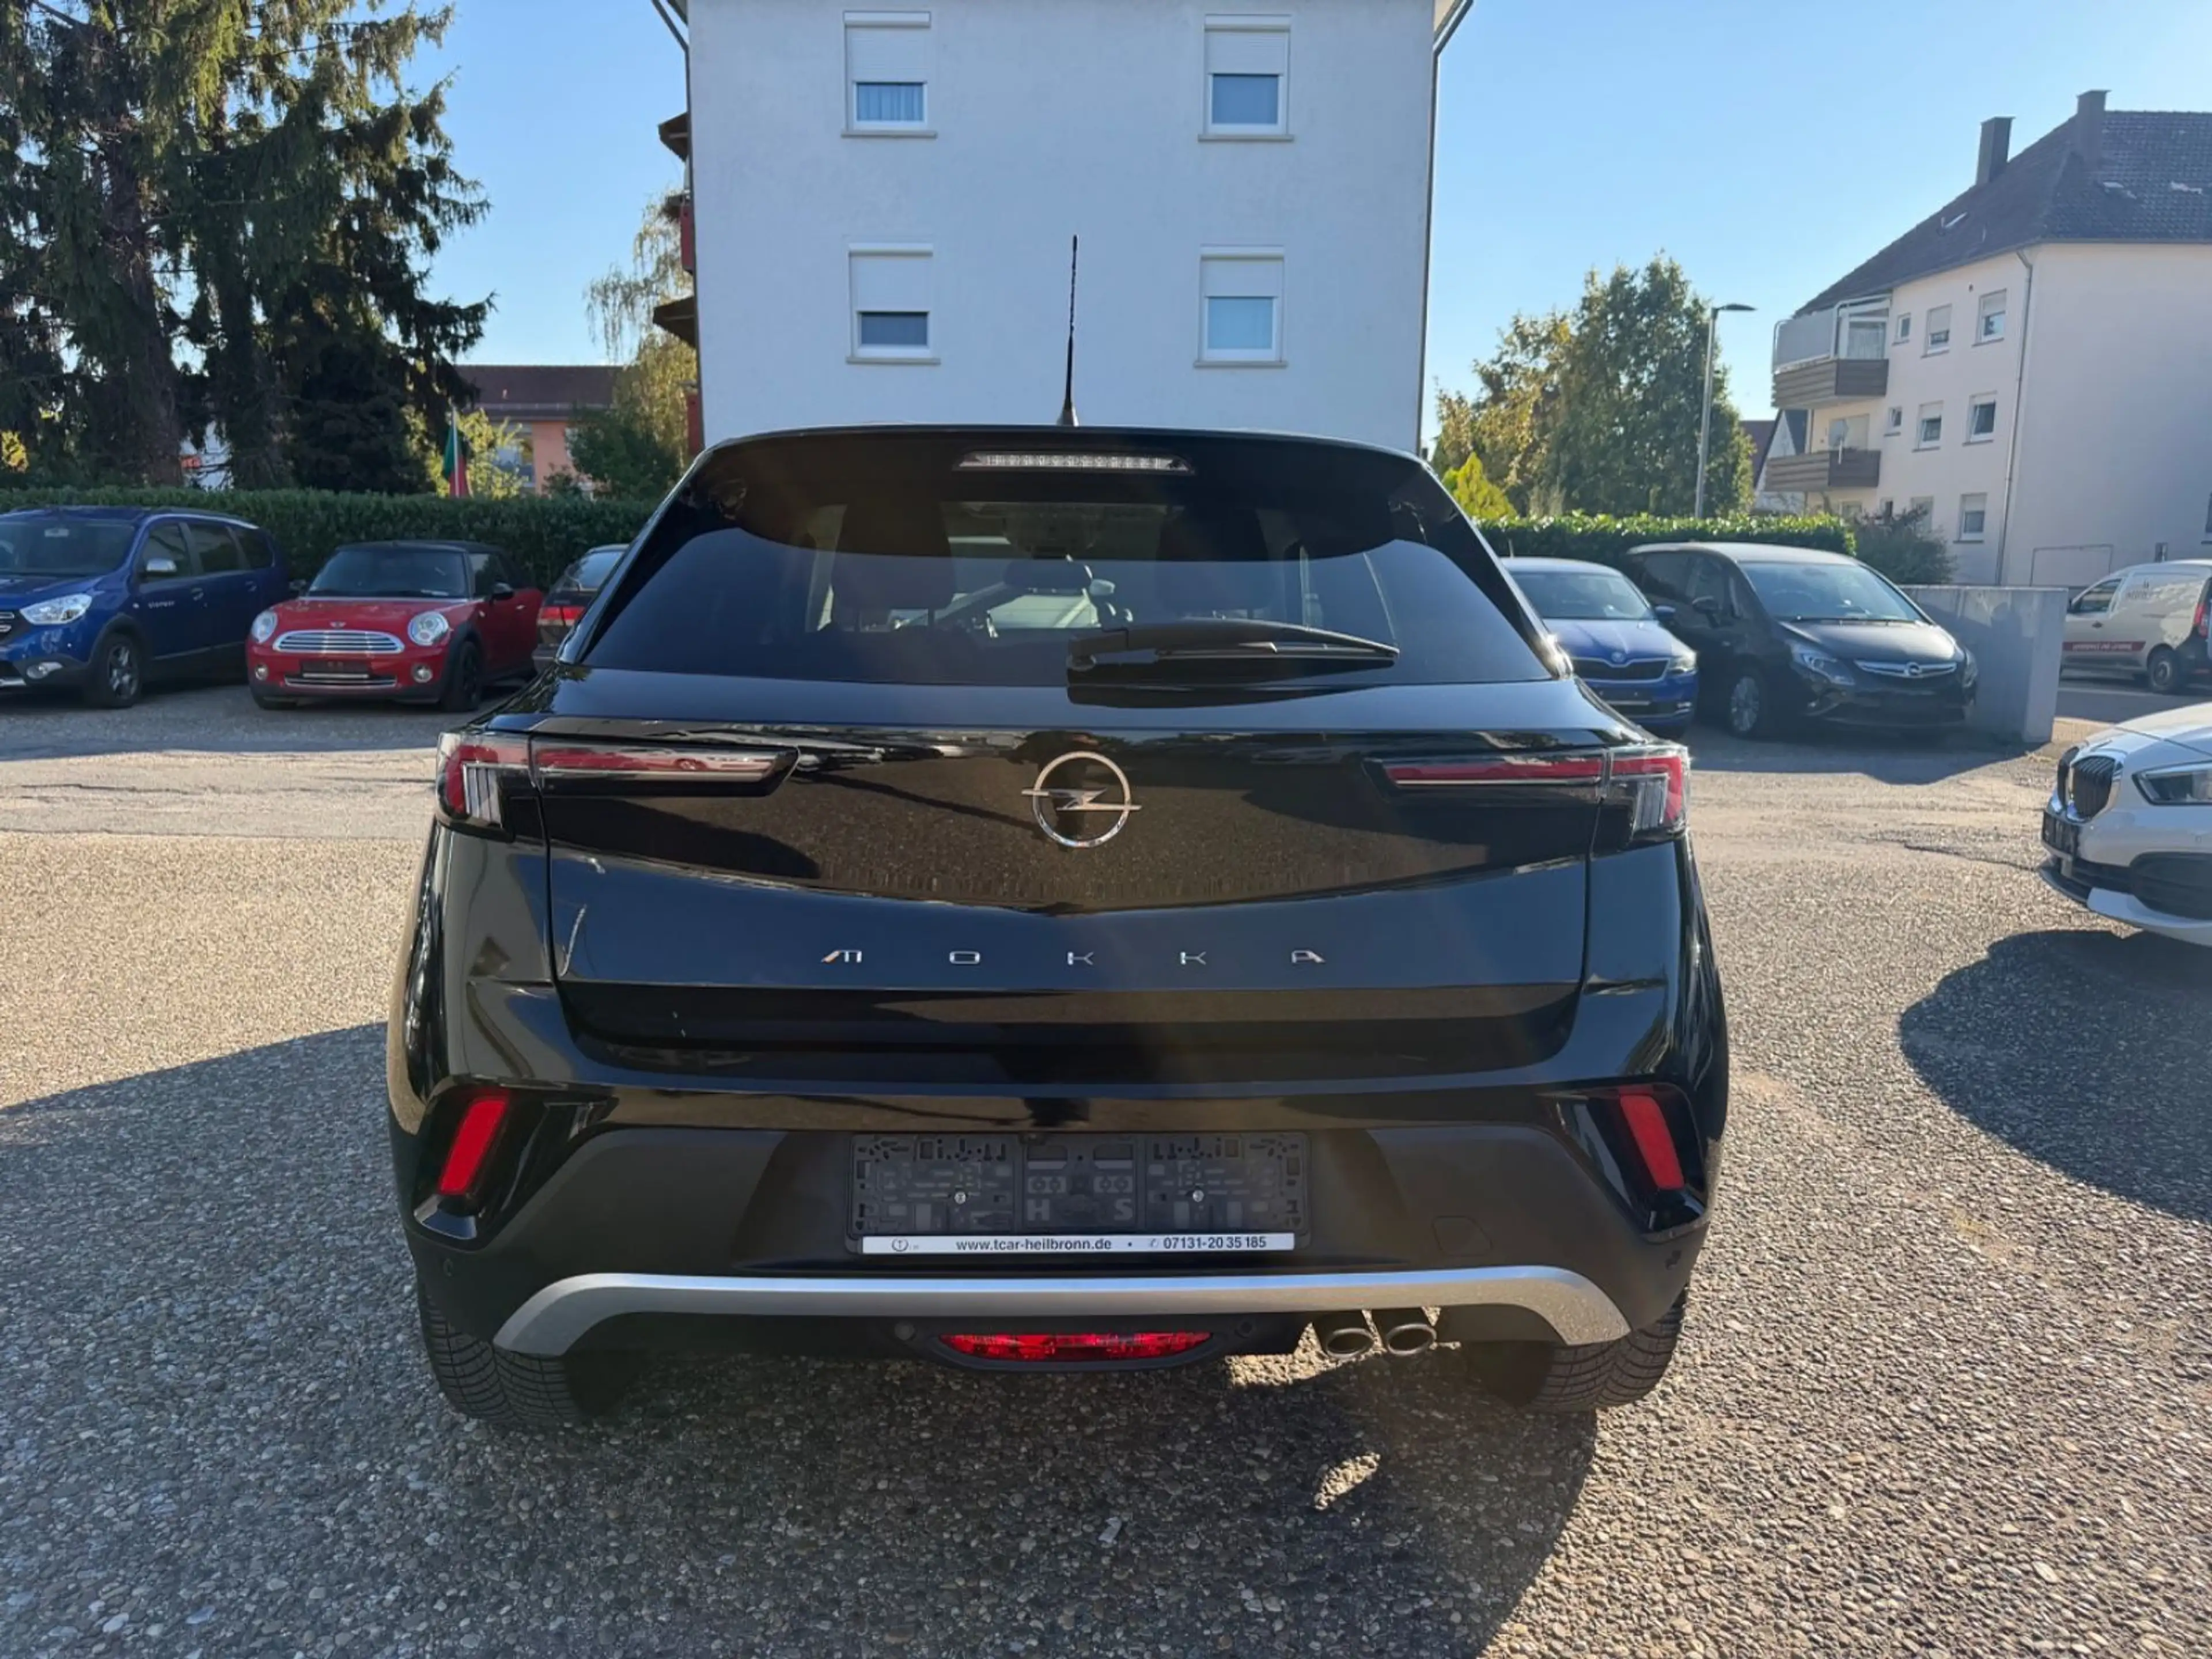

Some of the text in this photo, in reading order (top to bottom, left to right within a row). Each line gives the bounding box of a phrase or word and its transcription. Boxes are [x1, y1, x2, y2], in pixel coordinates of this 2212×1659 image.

[956, 1238, 1112, 1251] www.tcar-heilbronn.de
[1163, 1236, 1267, 1249] 07131-20 35 185
